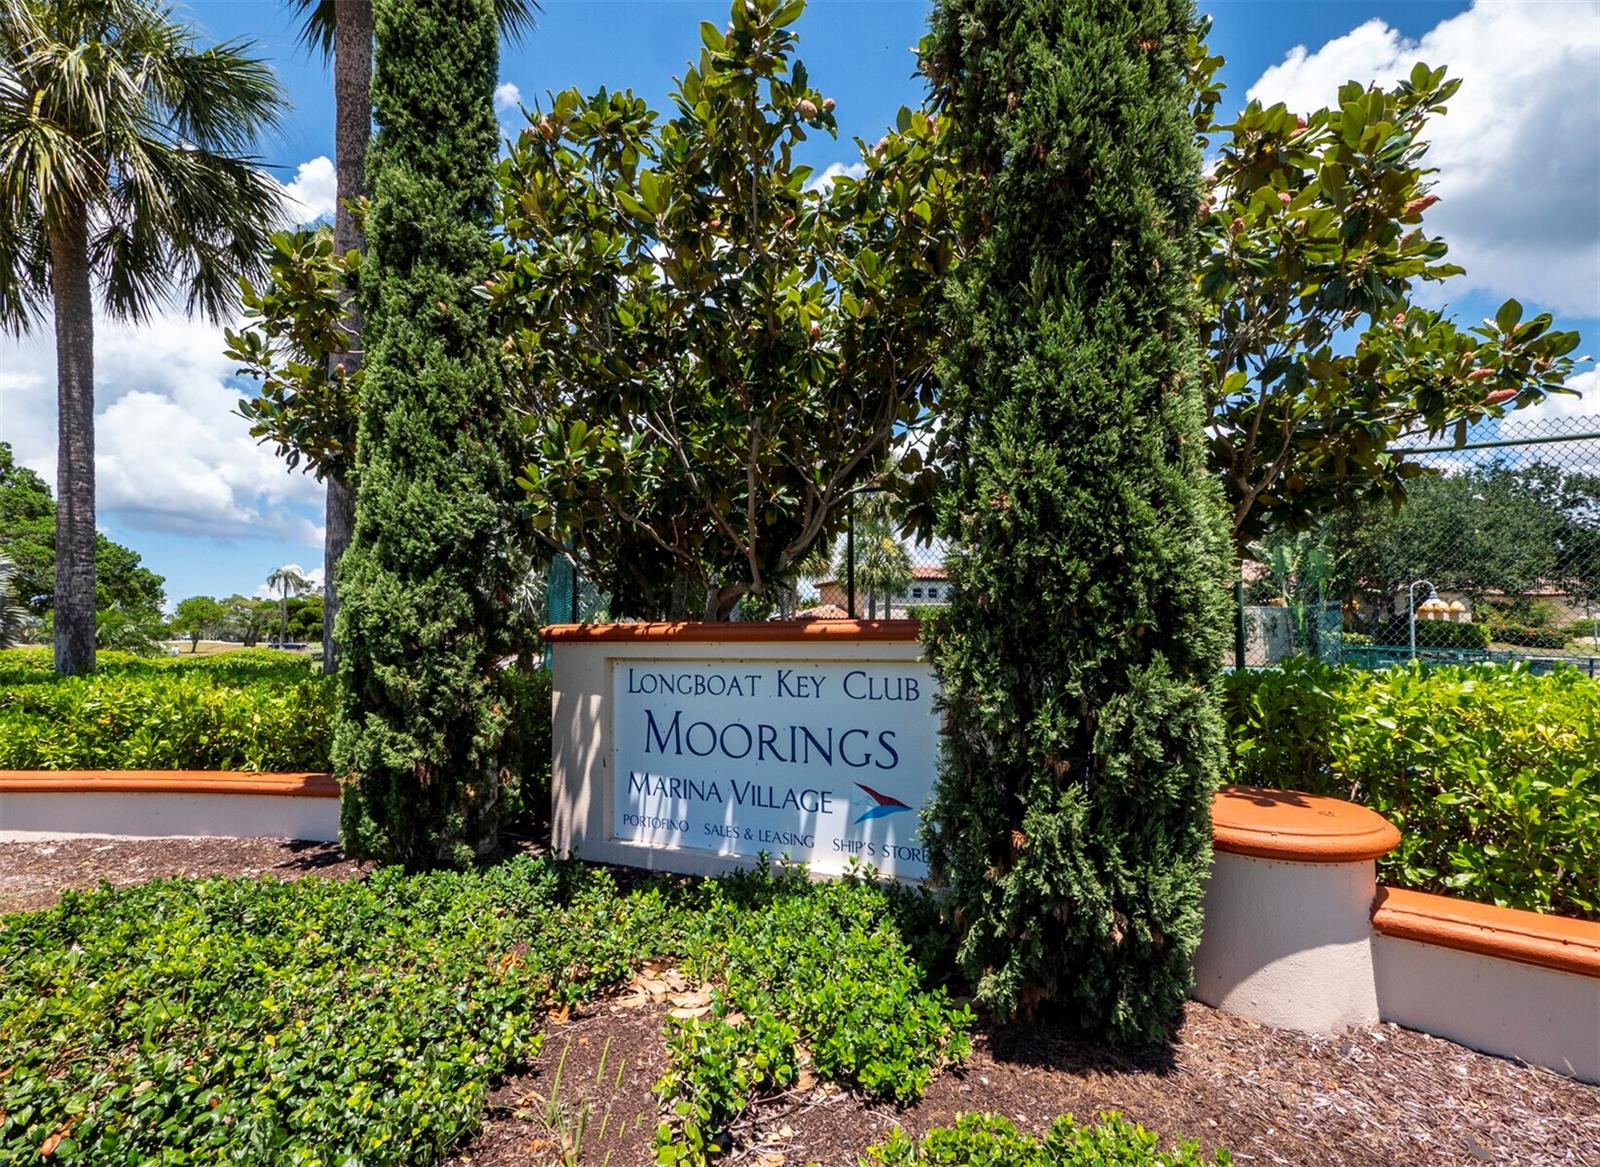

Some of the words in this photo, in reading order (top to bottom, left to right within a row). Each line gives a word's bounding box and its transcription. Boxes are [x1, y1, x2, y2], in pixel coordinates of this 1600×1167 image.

[628, 668, 762, 697] LONGBOAT
[776, 669, 827, 699] KEY
[842, 670, 920, 702] CLUB
[644, 708, 900, 771] MOORINGS
[627, 771, 723, 804] MARINA
[730, 779, 834, 814] VILLAGE
[622, 813, 690, 833] PORTOFINO
[703, 822, 740, 840] SALES
[743, 828, 753, 841] &
[758, 829, 816, 849] LEASING
[832, 838, 876, 857] SHIP'S
[881, 844, 930, 864] STORE
